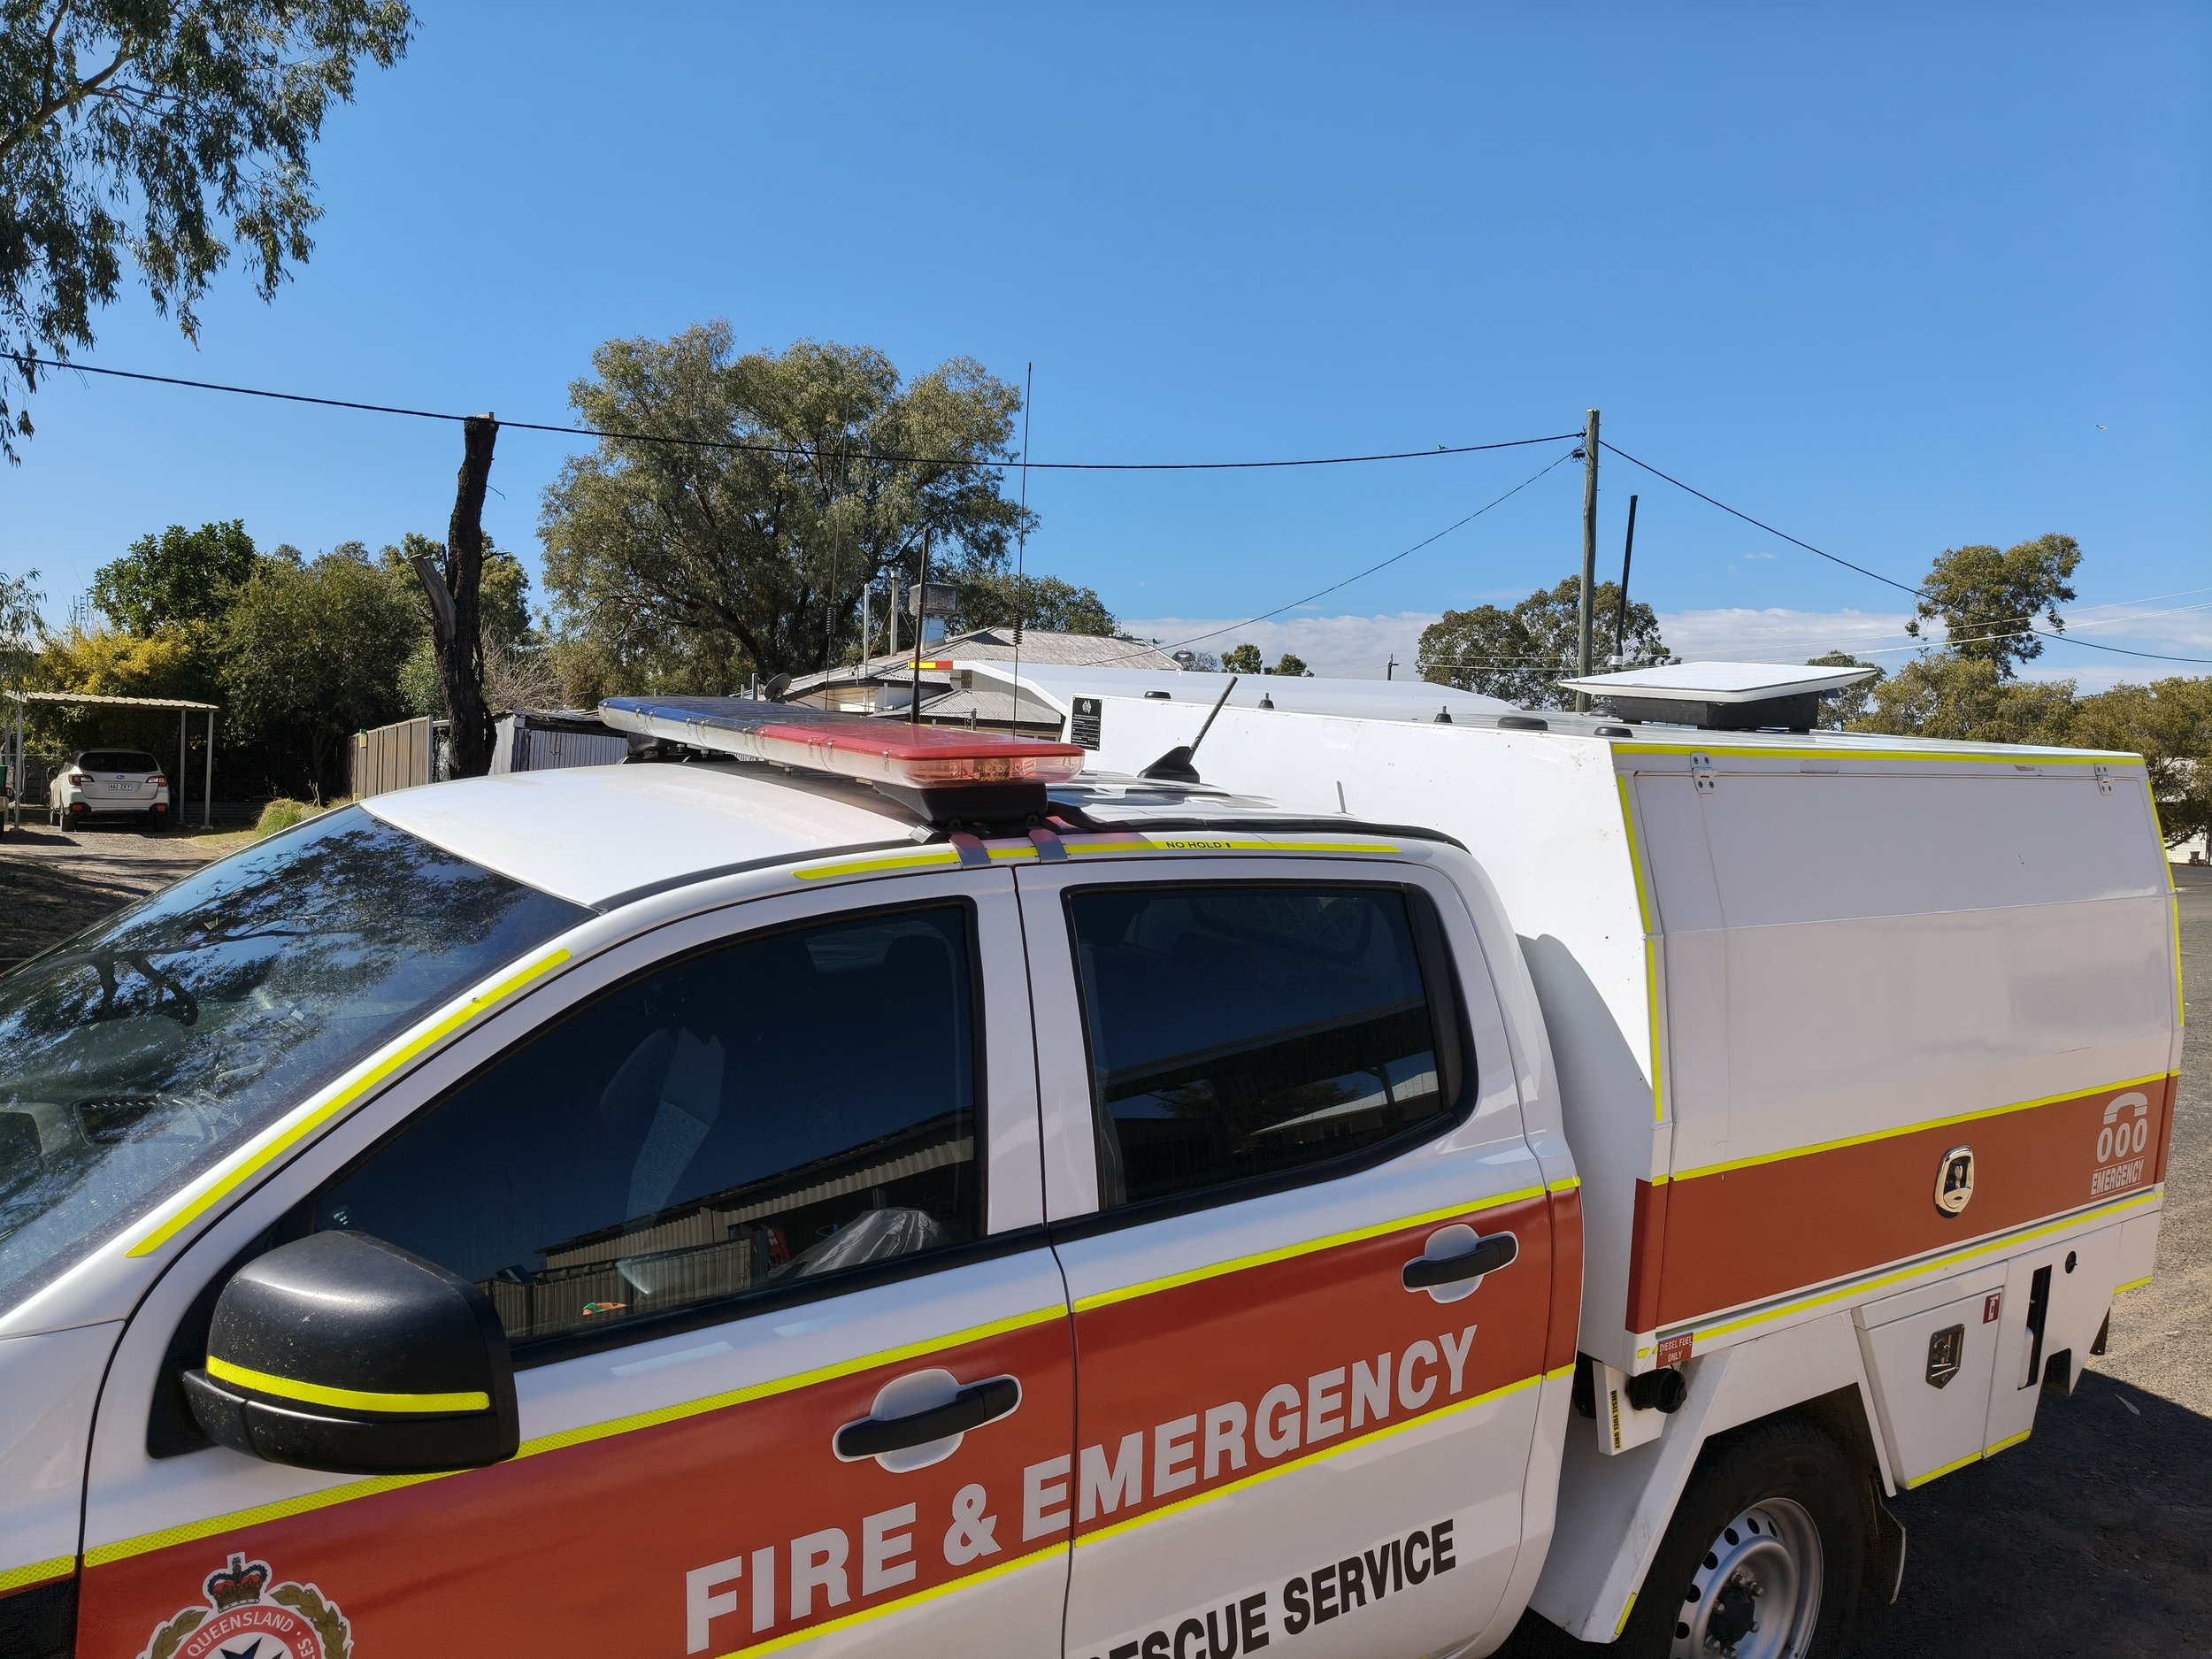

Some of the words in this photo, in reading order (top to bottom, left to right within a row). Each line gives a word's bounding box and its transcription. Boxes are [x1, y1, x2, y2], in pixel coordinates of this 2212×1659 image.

[2096, 1118, 2148, 1164] 000
[2091, 1159, 2144, 1196] EMERGENCY
[1659, 1340, 1678, 1352] DIESEL
[1679, 1335, 1692, 1348] FUEL
[1668, 1350, 1683, 1363] ONLY
[686, 1502, 917, 1655] FIRE
[943, 1483, 1002, 1566] &
[1022, 1324, 1478, 1542] EMERGENCY
[1283, 1518, 1456, 1636] SERVICE
[187, 1611, 295, 1658] QUEENSLAND
